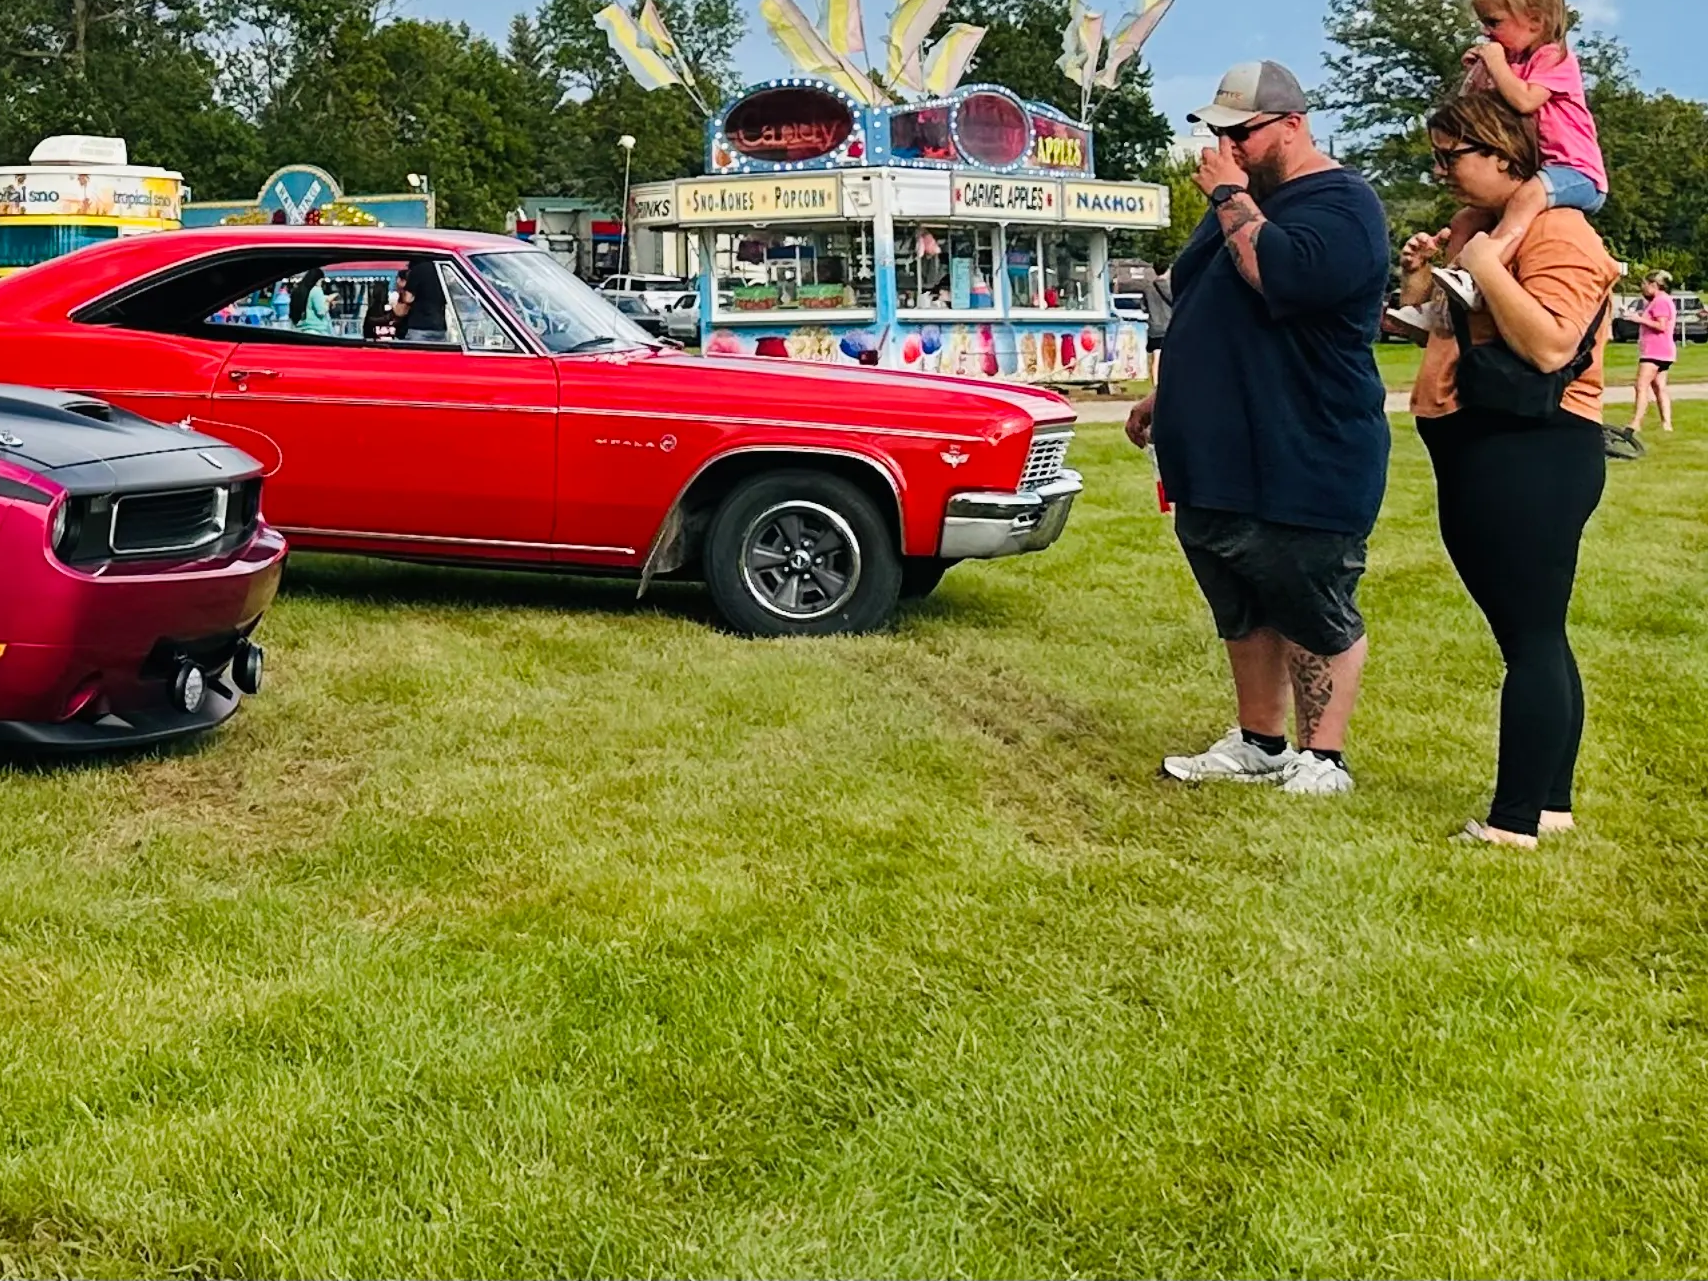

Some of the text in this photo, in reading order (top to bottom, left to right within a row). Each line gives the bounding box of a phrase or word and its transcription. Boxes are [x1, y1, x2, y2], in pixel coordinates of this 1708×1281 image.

[1037, 135, 1082, 167] APPLES
[28, 190, 59, 203] sno
[964, 181, 1044, 211] CARMEL APPLES
[1076, 192, 1145, 214] NACHOS
